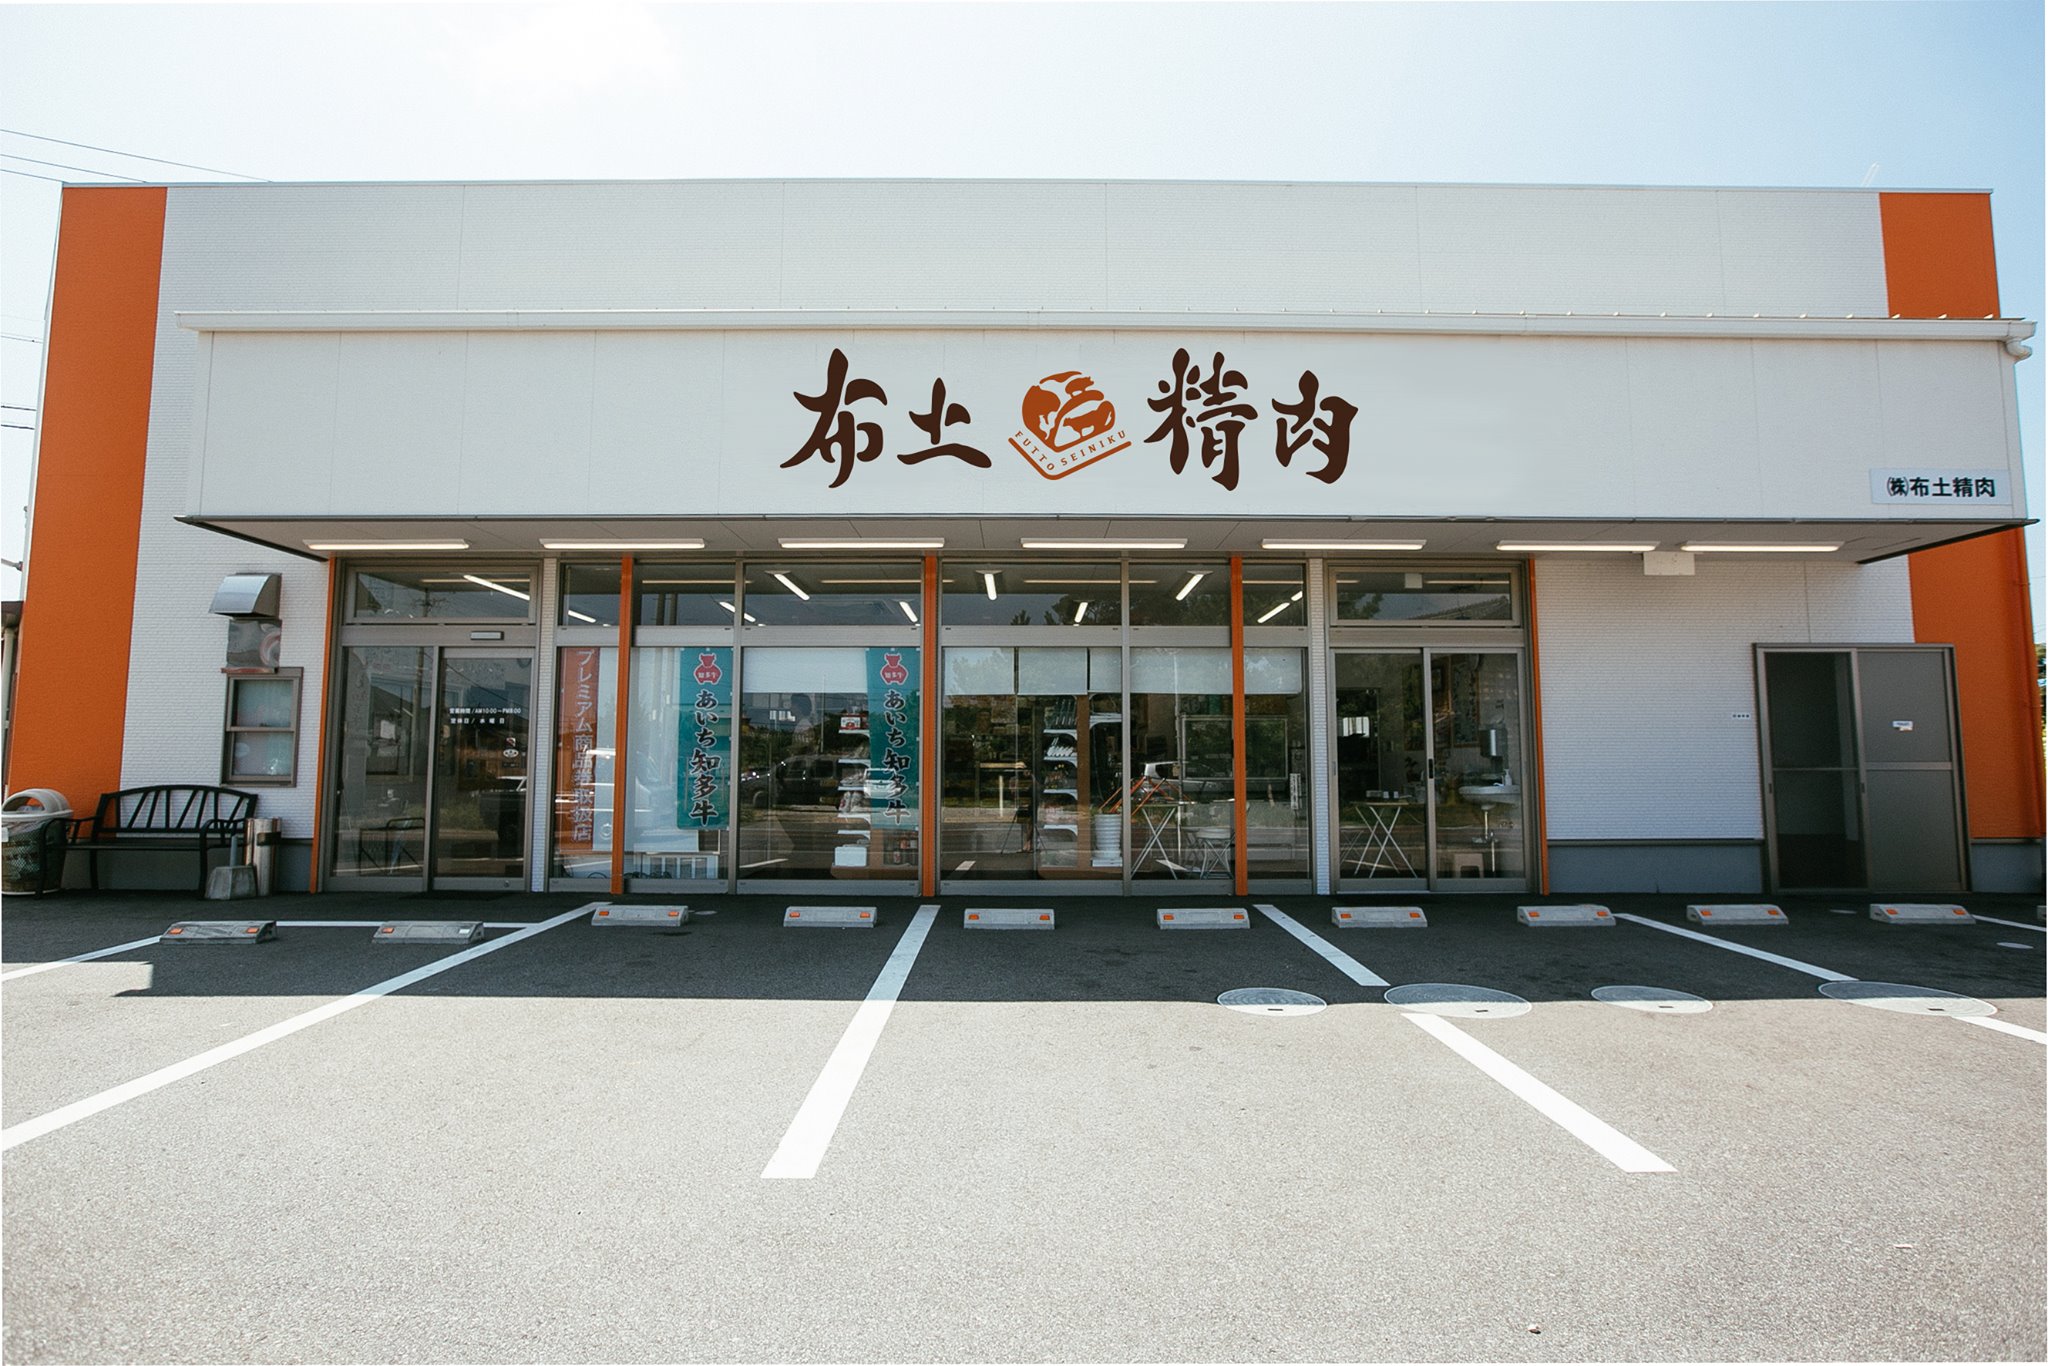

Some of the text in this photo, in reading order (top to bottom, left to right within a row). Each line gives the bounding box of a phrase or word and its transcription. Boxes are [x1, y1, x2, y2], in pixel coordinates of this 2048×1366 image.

[780, 348, 1359, 491] 布土 精肉
[1015, 430, 1126, 471] FUTTO SEINIKU
[689, 689, 721, 826] あいち知多牛
[882, 689, 911, 825] あいち知多牛
